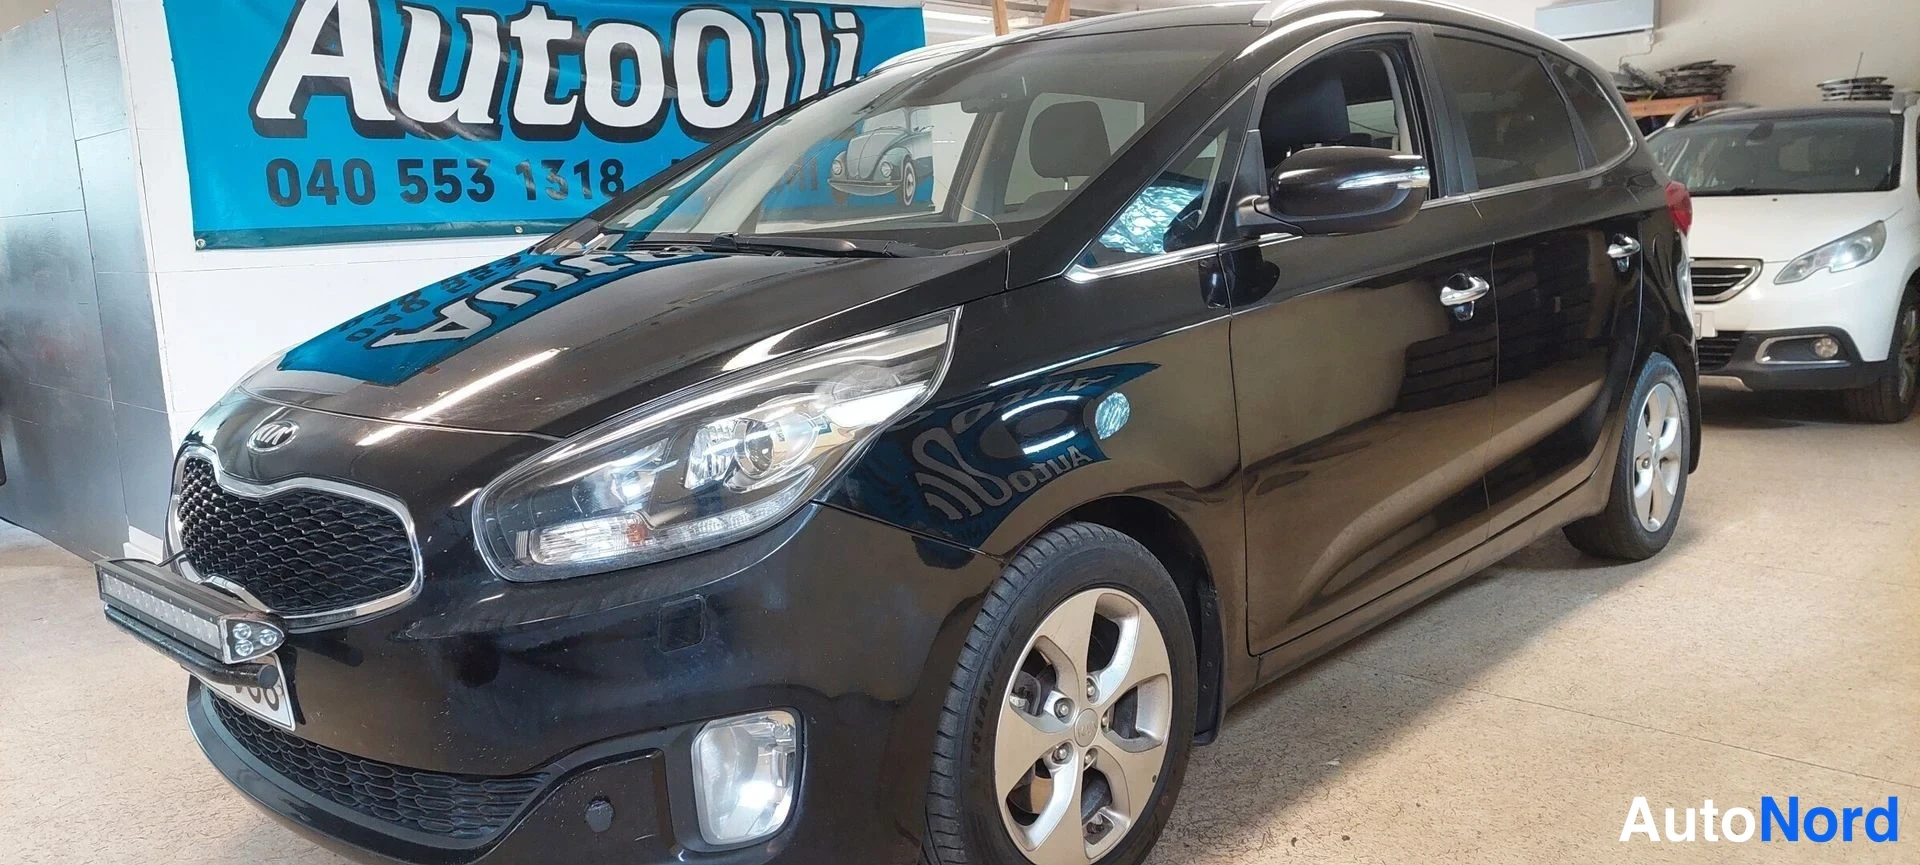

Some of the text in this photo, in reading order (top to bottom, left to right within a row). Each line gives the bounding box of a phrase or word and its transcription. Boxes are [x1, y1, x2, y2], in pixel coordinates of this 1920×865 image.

[252, 0, 862, 136] AutoOlli
[266, 158, 625, 207] 040 553 1318
